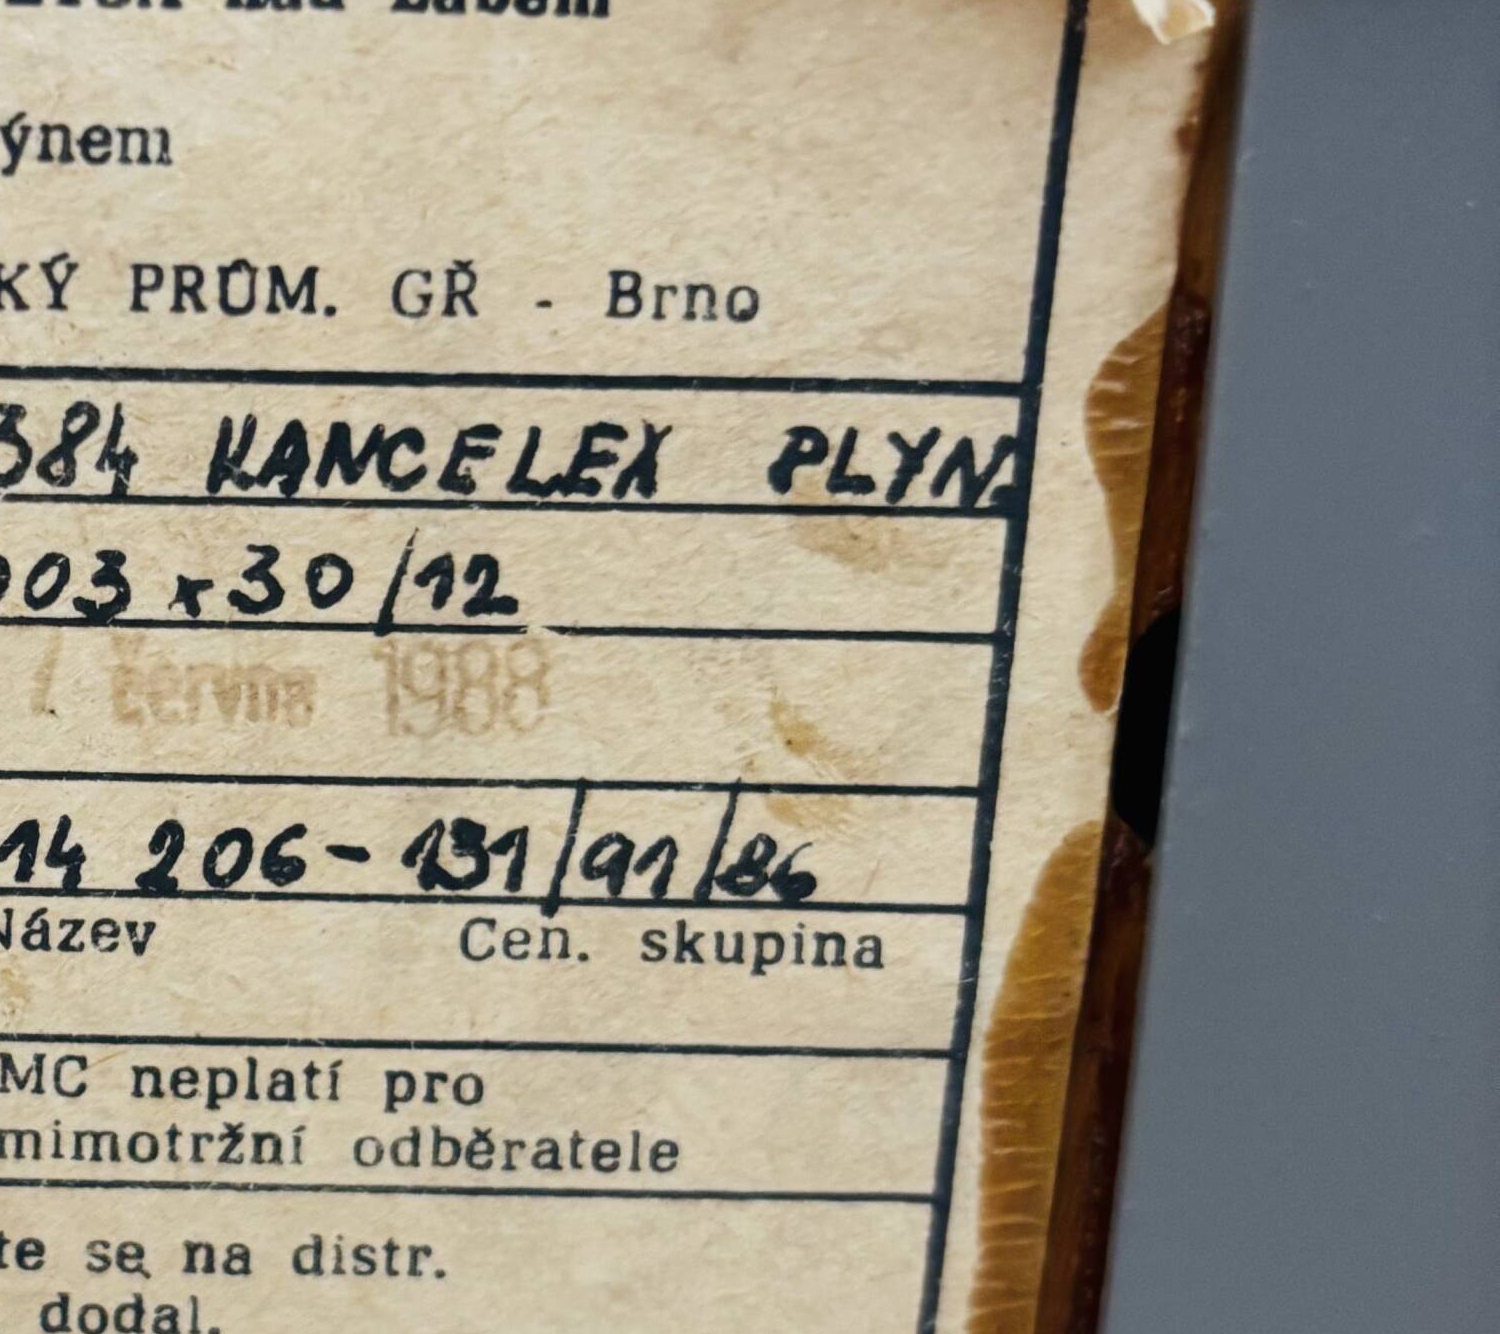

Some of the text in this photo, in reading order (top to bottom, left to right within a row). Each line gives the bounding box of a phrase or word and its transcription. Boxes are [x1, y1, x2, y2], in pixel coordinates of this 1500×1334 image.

[127, 256, 339, 319] PRŮM.
[389, 257, 480, 321] GŘ
[603, 268, 761, 325] Brno
[206, 409, 673, 499] KANCELEX
[372, 636, 552, 739] 1988
[458, 915, 591, 964] Cen.
[639, 917, 886, 978] skupina
[129, 1054, 345, 1113] neplatí
[382, 1068, 486, 1115] pro
[352, 1124, 681, 1176] odběratele
[84, 1238, 153, 1281] se
[180, 1238, 254, 1279] na
[290, 1232, 448, 1281] distr.
